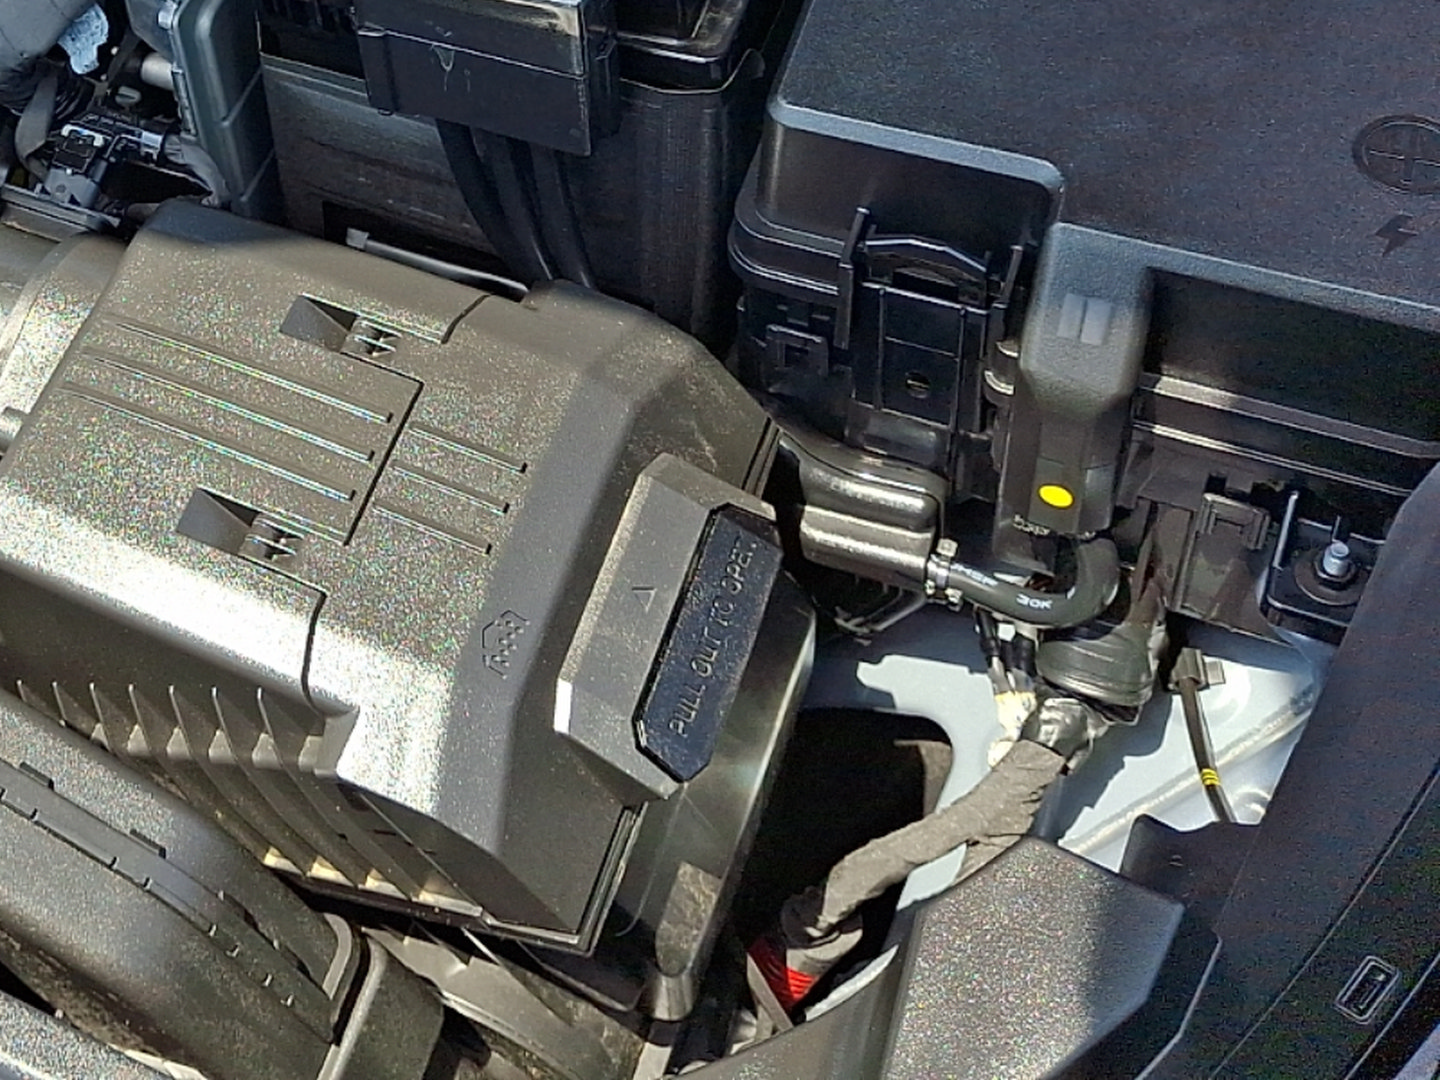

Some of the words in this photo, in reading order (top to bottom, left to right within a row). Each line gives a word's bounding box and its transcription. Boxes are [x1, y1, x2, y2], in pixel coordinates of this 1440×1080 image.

[668, 682, 707, 739] PULL
[691, 626, 723, 678] OUT
[708, 595, 736, 627] TO
